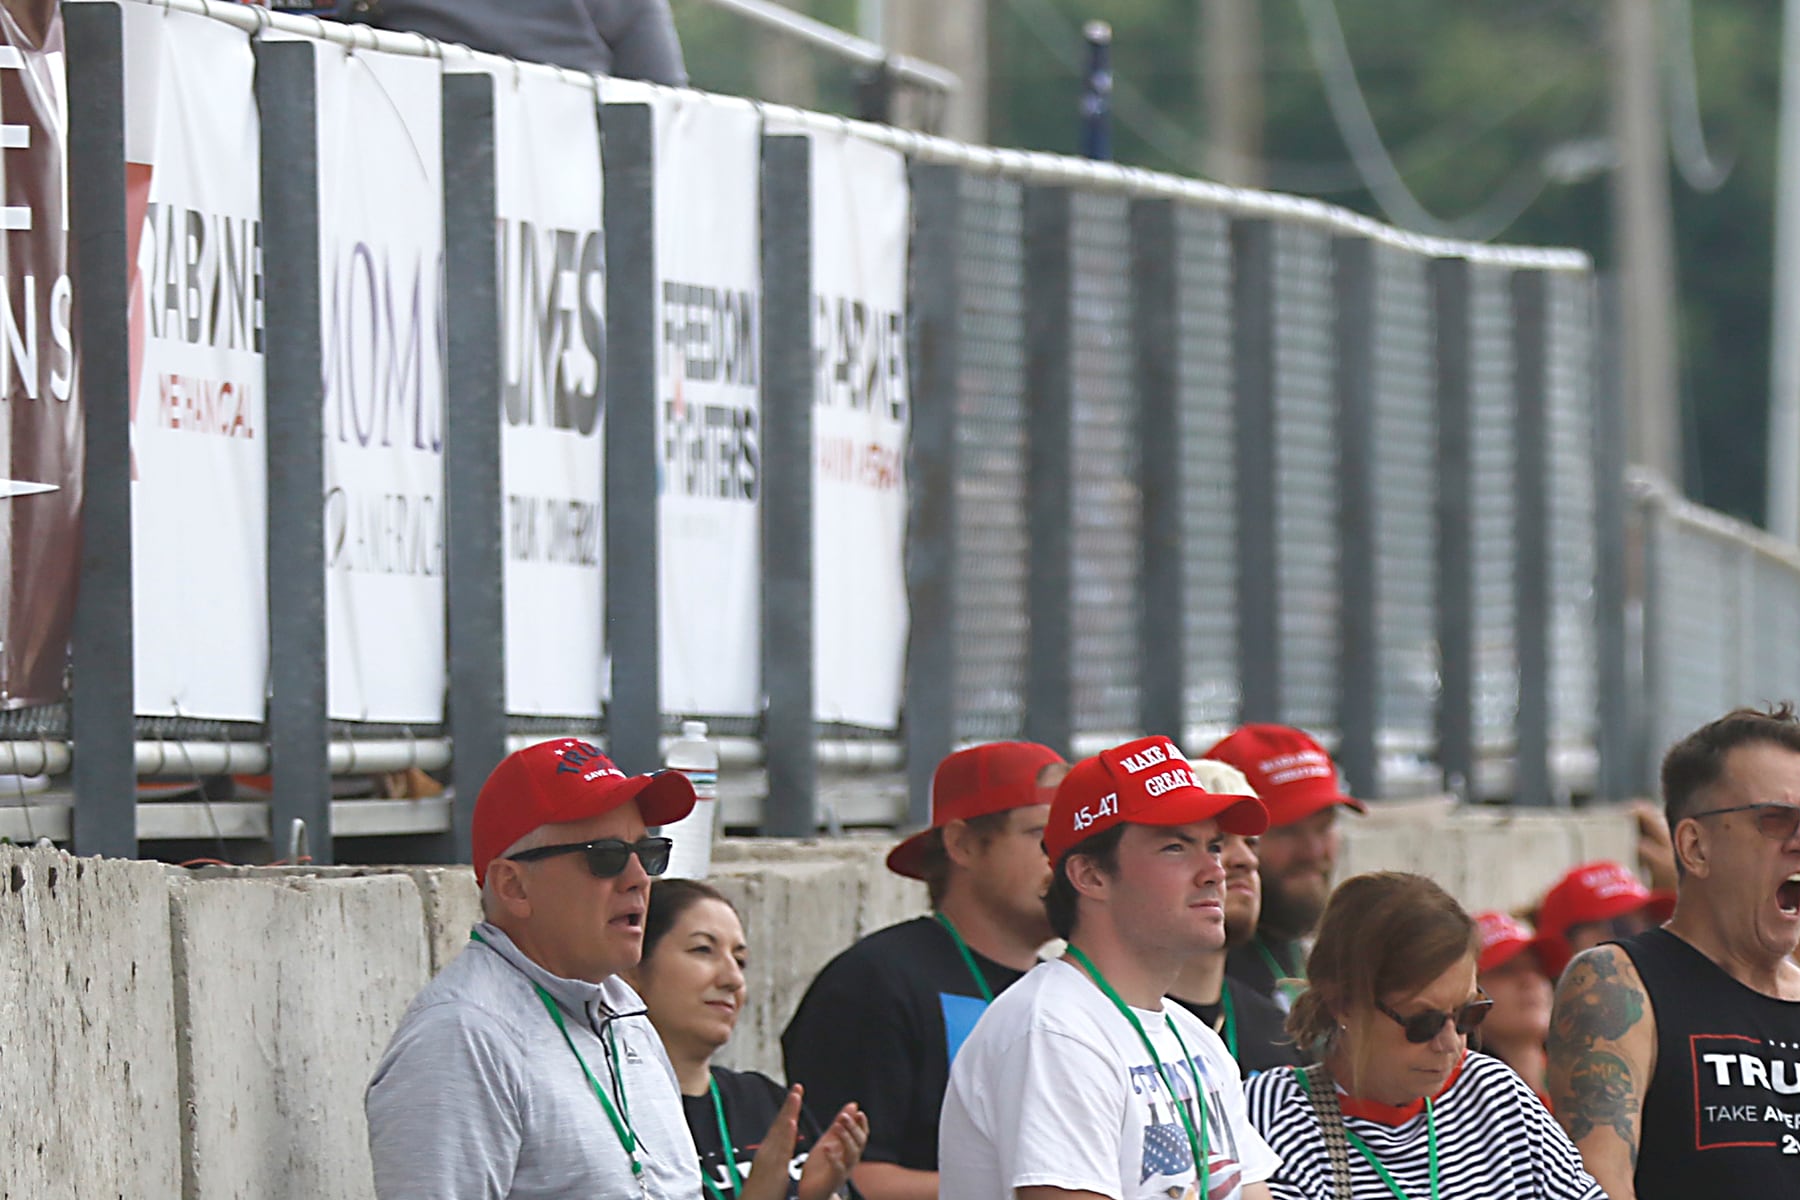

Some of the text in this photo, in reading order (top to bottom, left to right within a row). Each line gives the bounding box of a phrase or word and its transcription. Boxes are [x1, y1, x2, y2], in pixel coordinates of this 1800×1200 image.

[1120, 745, 1168, 774] MAKE
[1145, 768, 1191, 797] GREAT
[1073, 793, 1120, 831] 45-47
[1705, 1105, 1757, 1122] TAKE
